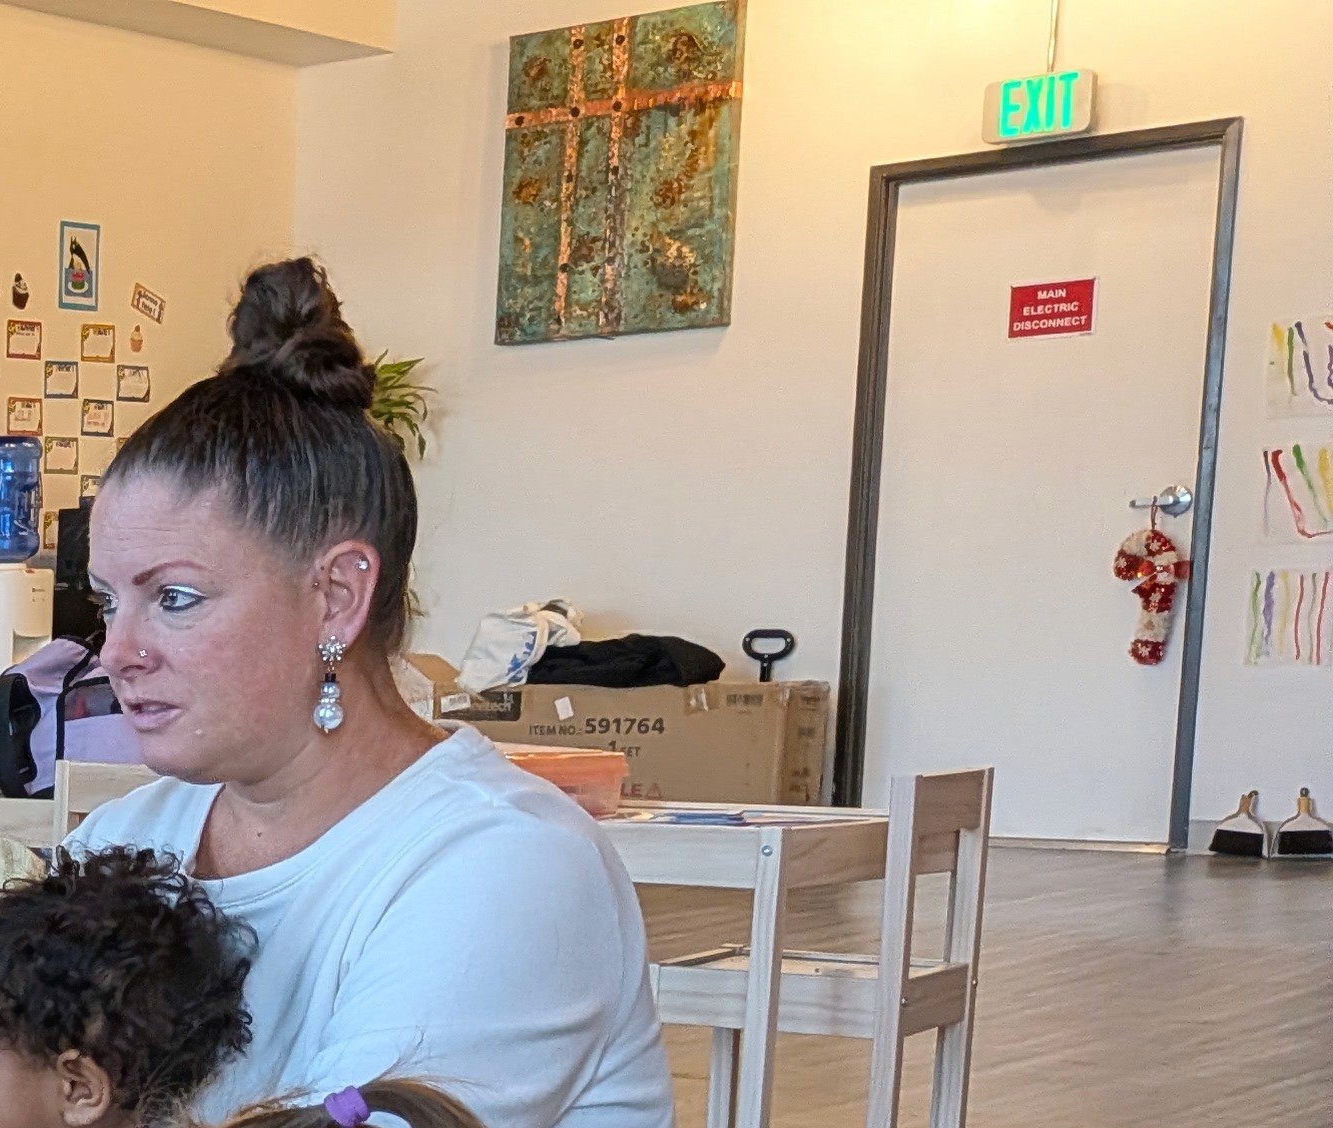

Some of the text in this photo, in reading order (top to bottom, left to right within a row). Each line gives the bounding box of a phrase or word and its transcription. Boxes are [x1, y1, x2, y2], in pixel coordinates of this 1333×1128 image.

[999, 71, 1079, 137] EXIT
[1037, 288, 1067, 300] MAIN
[1023, 302, 1080, 316] ELECTRIC
[1013, 315, 1088, 332] DISCONNECT
[529, 724, 555, 736] ITEM
[585, 717, 665, 735] 591764
